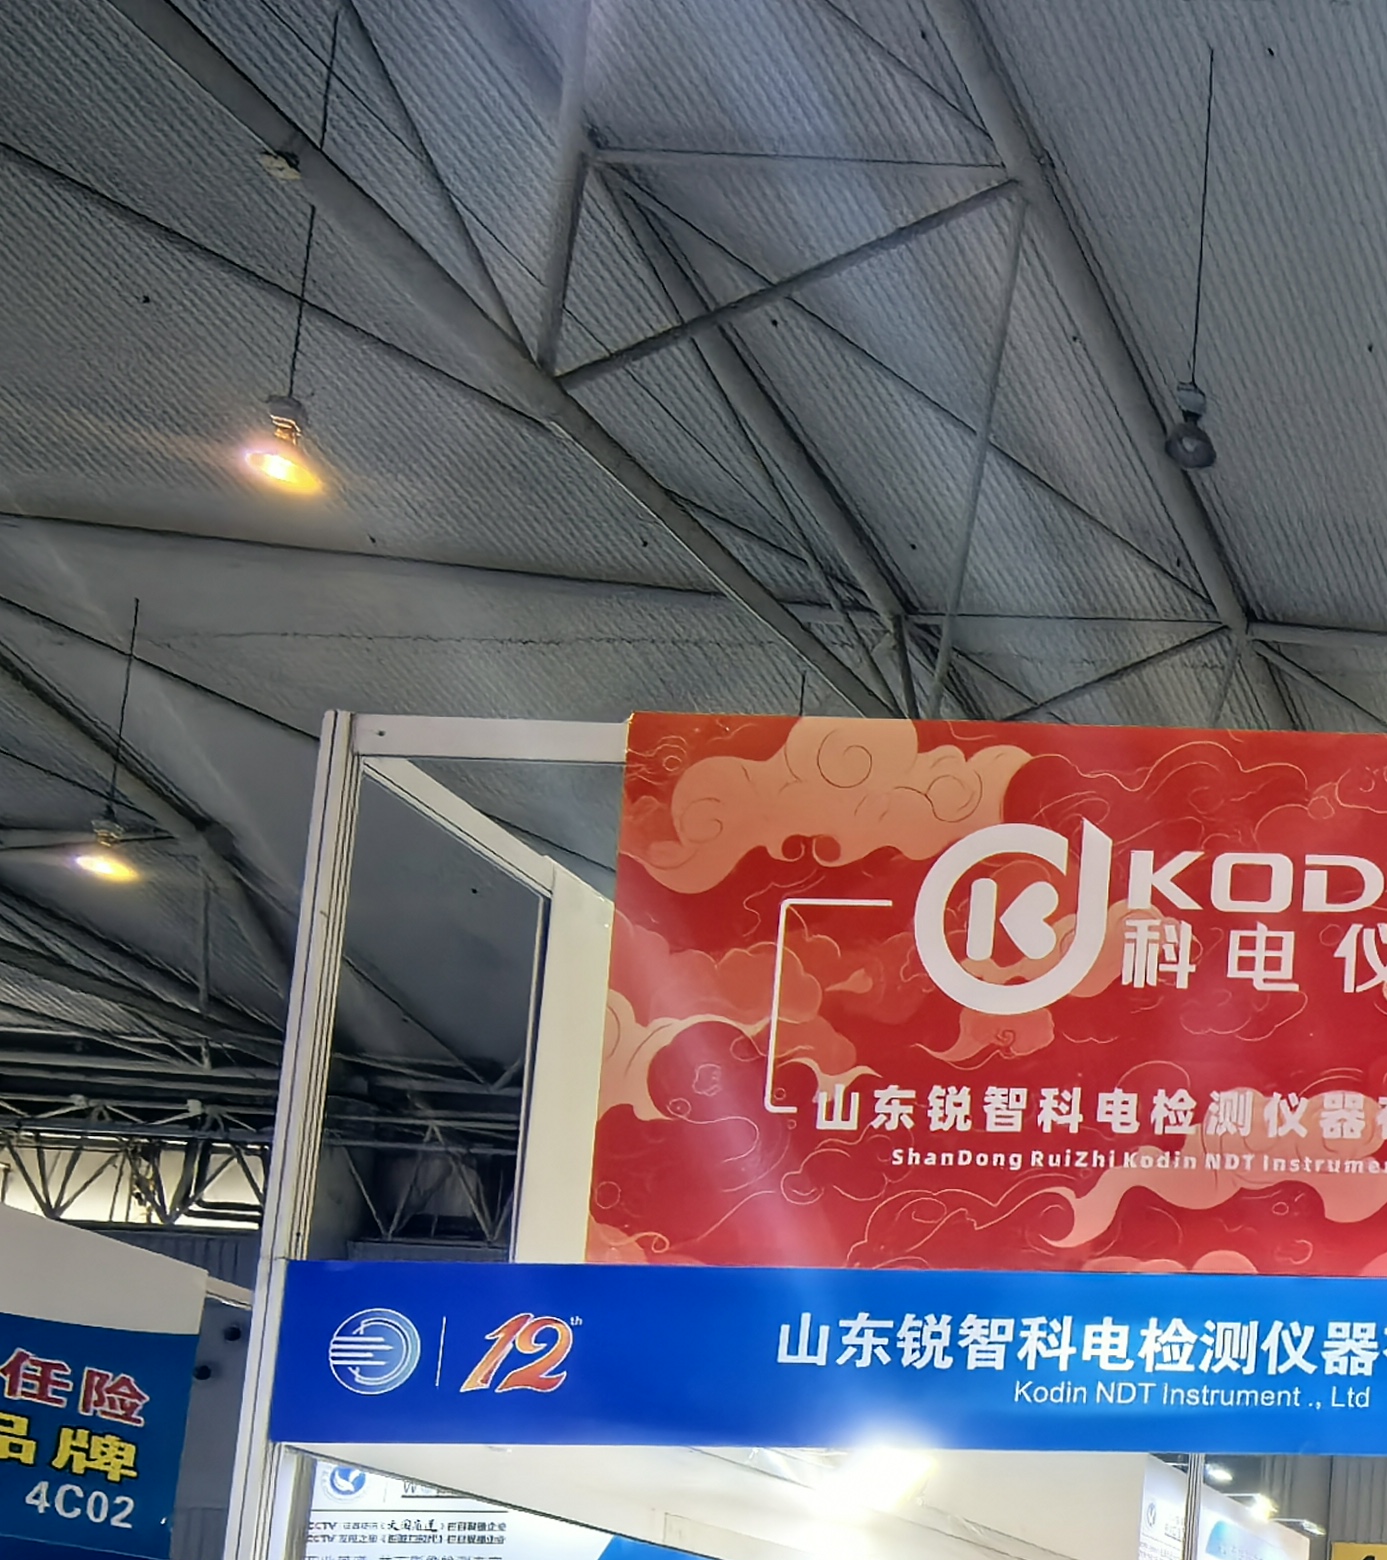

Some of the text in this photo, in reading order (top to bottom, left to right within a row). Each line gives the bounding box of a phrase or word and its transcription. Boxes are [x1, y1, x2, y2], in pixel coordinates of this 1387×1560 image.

[891, 1147, 1022, 1172] ShanDong
[1029, 1150, 1117, 1171] RuiZhi
[1122, 1153, 1198, 1171] Kodin
[1204, 1155, 1255, 1173] NDT
[0, 1347, 150, 1428] 任险
[1014, 1380, 1088, 1405] Kodin
[1095, 1382, 1154, 1405] NDT
[1161, 1384, 1300, 1408] Instrument
[1330, 1385, 1371, 1409] Ltd
[25, 1480, 136, 1530] 4C02
